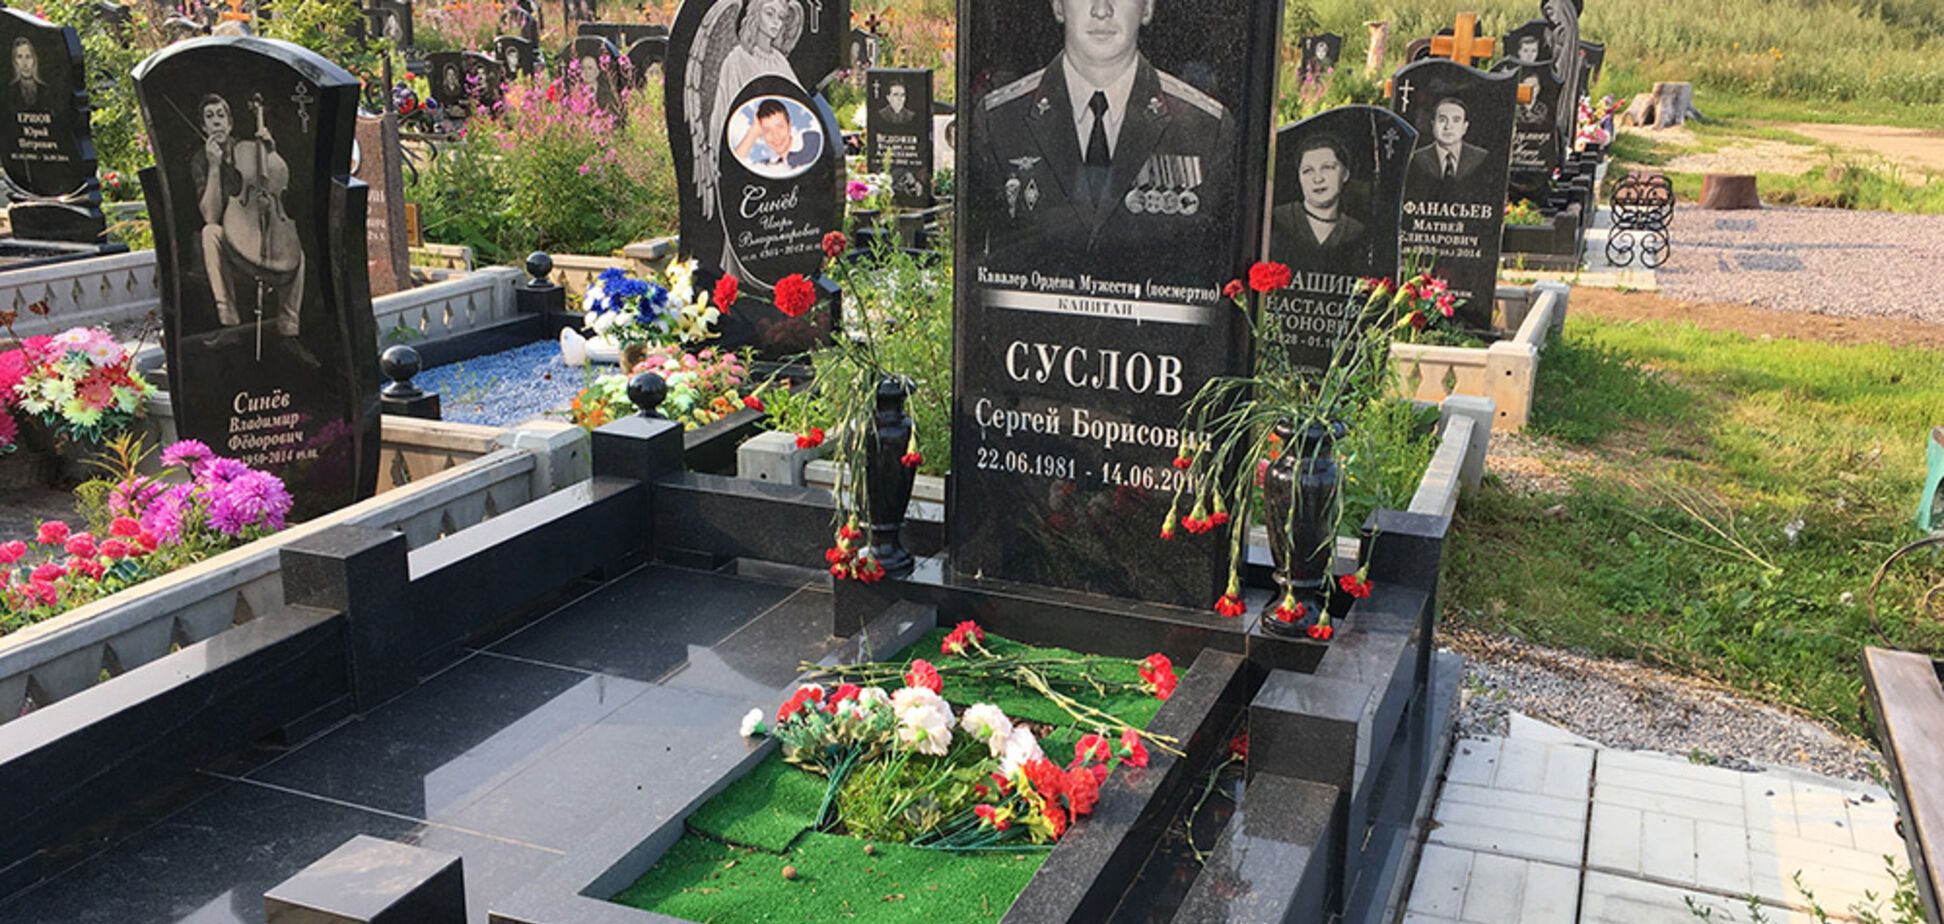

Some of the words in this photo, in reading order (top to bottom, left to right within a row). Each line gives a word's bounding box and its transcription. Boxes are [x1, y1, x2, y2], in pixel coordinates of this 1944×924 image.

[740, 184, 799, 219] Синёв
[1403, 201, 1493, 219] ФАНАСЬЕВ
[977, 266, 1028, 289] Кавалер
[1031, 270, 1075, 291] Ордена
[1079, 274, 1141, 299] Мужества
[1145, 277, 1220, 304] (посмертно)
[1058, 298, 1133, 316] КАПИТАН
[1005, 340, 1184, 397] СУСЛОВ
[233, 389, 291, 414] Синёв
[228, 412, 300, 433] Владимир
[975, 397, 1060, 438] Сергей
[227, 431, 304, 451] Фёдорович
[977, 446, 1075, 481] 22.06.1981
